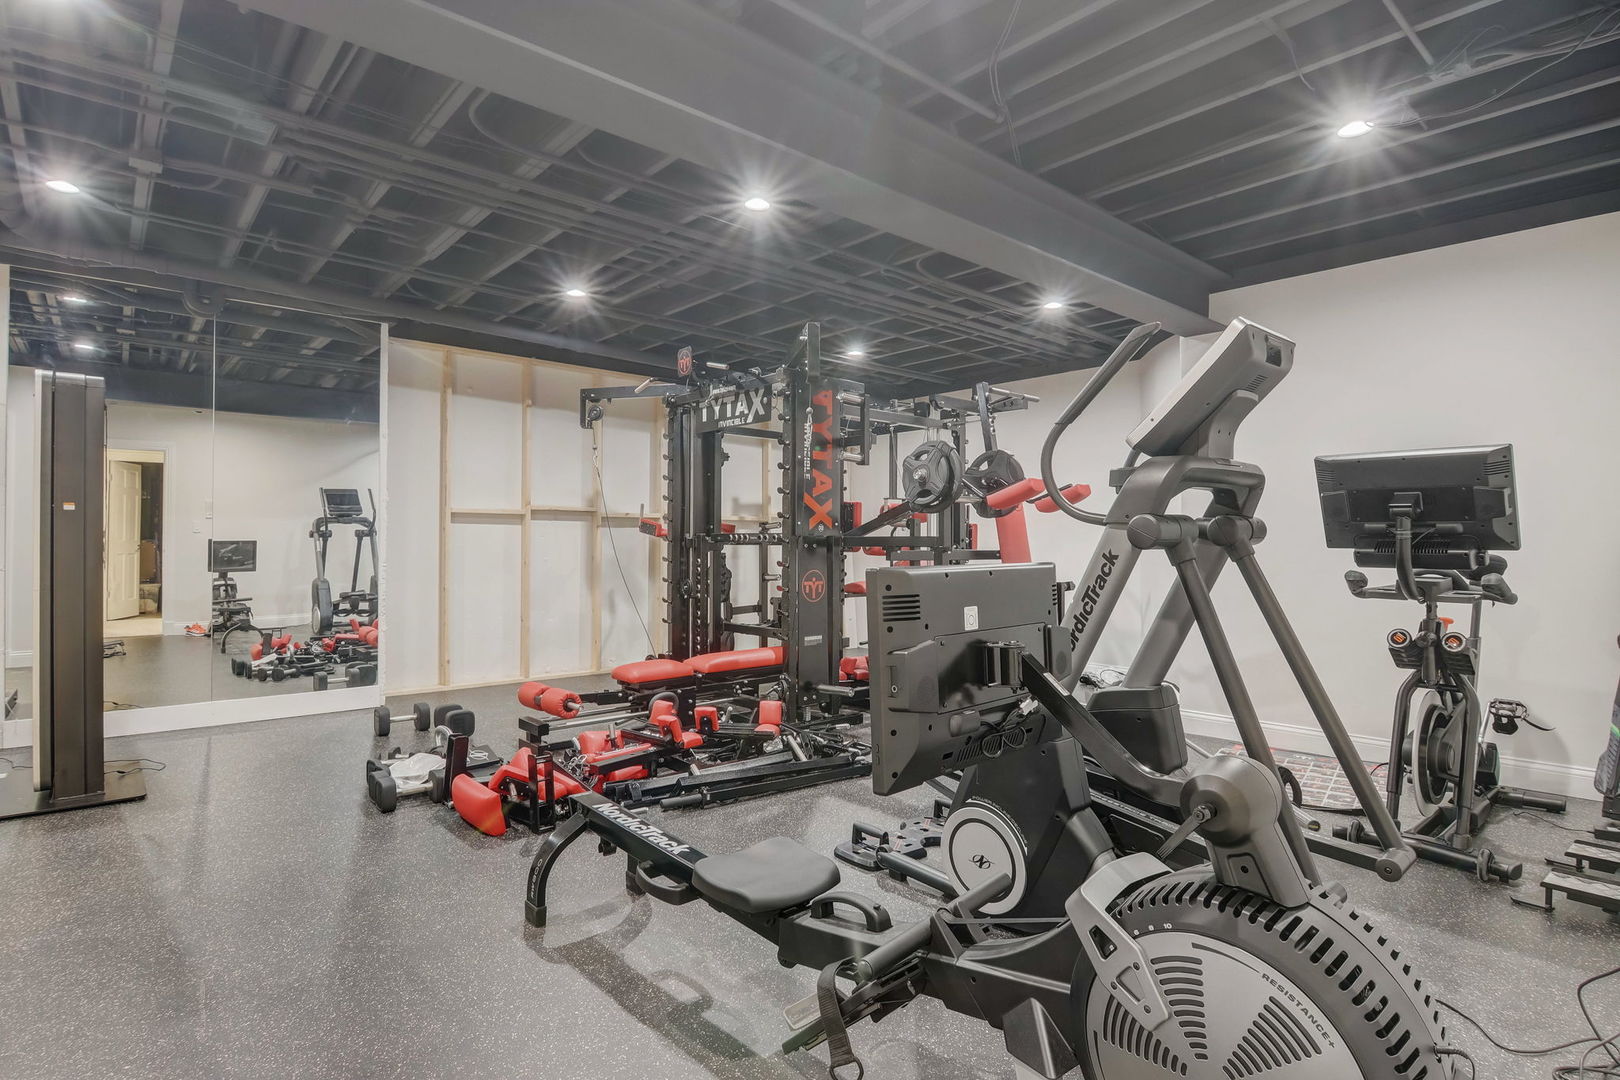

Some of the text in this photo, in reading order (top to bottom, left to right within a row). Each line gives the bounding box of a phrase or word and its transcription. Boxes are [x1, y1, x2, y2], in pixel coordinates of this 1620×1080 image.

[699, 387, 766, 423] TYTAX
[803, 390, 832, 529] TYTAX
[1070, 548, 1120, 652] rdicTrack
[592, 802, 691, 855] NordicTrack
[1163, 922, 1172, 930] 10
[1261, 973, 1335, 1048] RESISTANCE+
